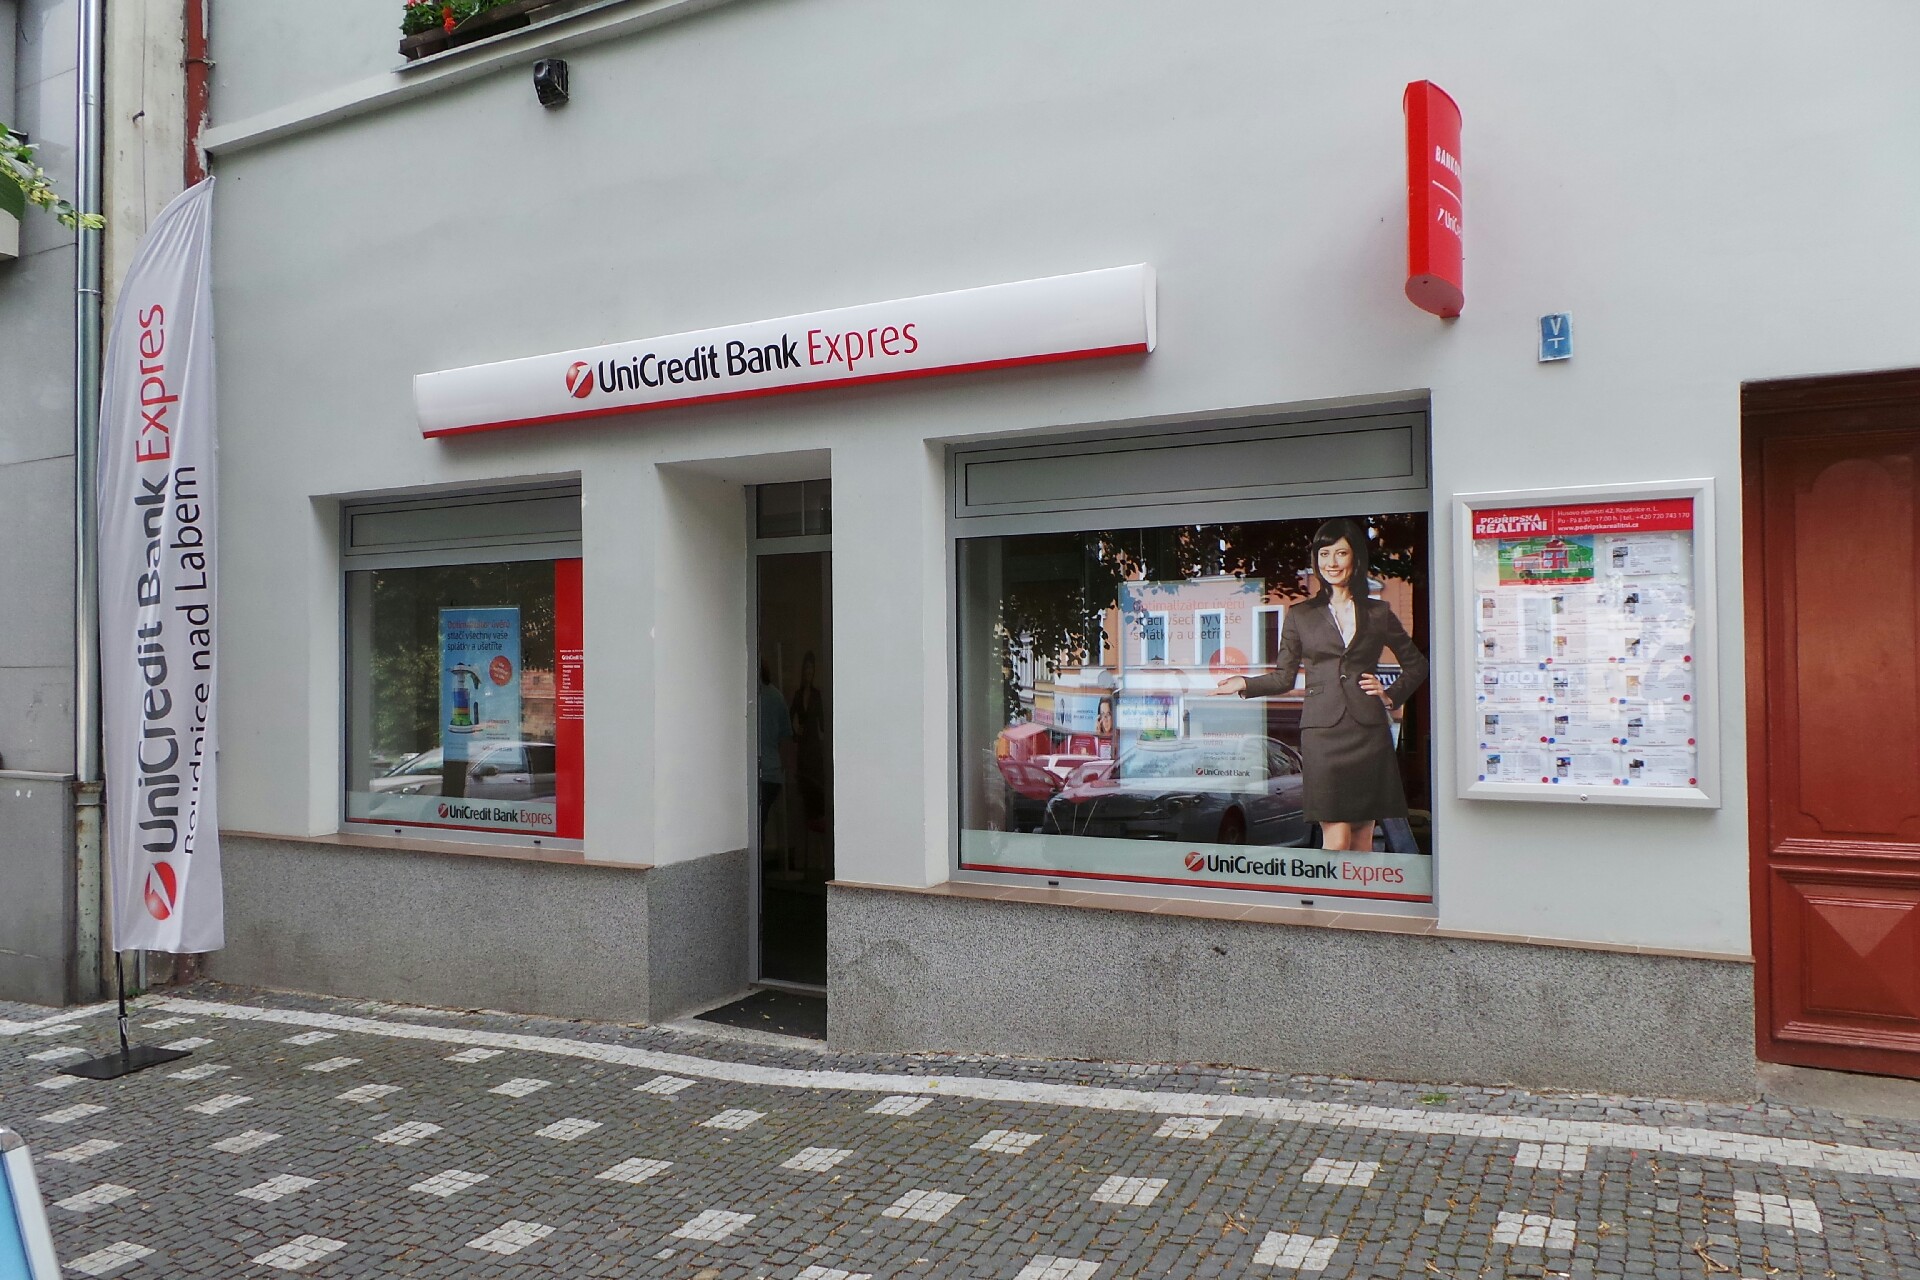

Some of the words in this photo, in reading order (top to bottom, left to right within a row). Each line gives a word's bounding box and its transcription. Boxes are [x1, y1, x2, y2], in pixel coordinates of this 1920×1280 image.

[135, 304, 179, 463] Expres
[598, 345, 721, 394] UniCredit
[726, 333, 802, 376] Bank
[807, 322, 919, 372] Expres
[134, 472, 170, 608] Bank
[170, 466, 208, 591] Labem
[175, 604, 211, 671] nad
[137, 620, 181, 853] UniCredit
[1203, 768, 1233, 777] UniCredit
[1233, 769, 1251, 777] Bank
[449, 804, 492, 821] UniCredit
[493, 807, 519, 823] Bank
[520, 809, 553, 827] Expres
[1207, 855, 1287, 876] UniCredit
[1291, 858, 1338, 880] Bank
[1342, 861, 1404, 886] Expres
